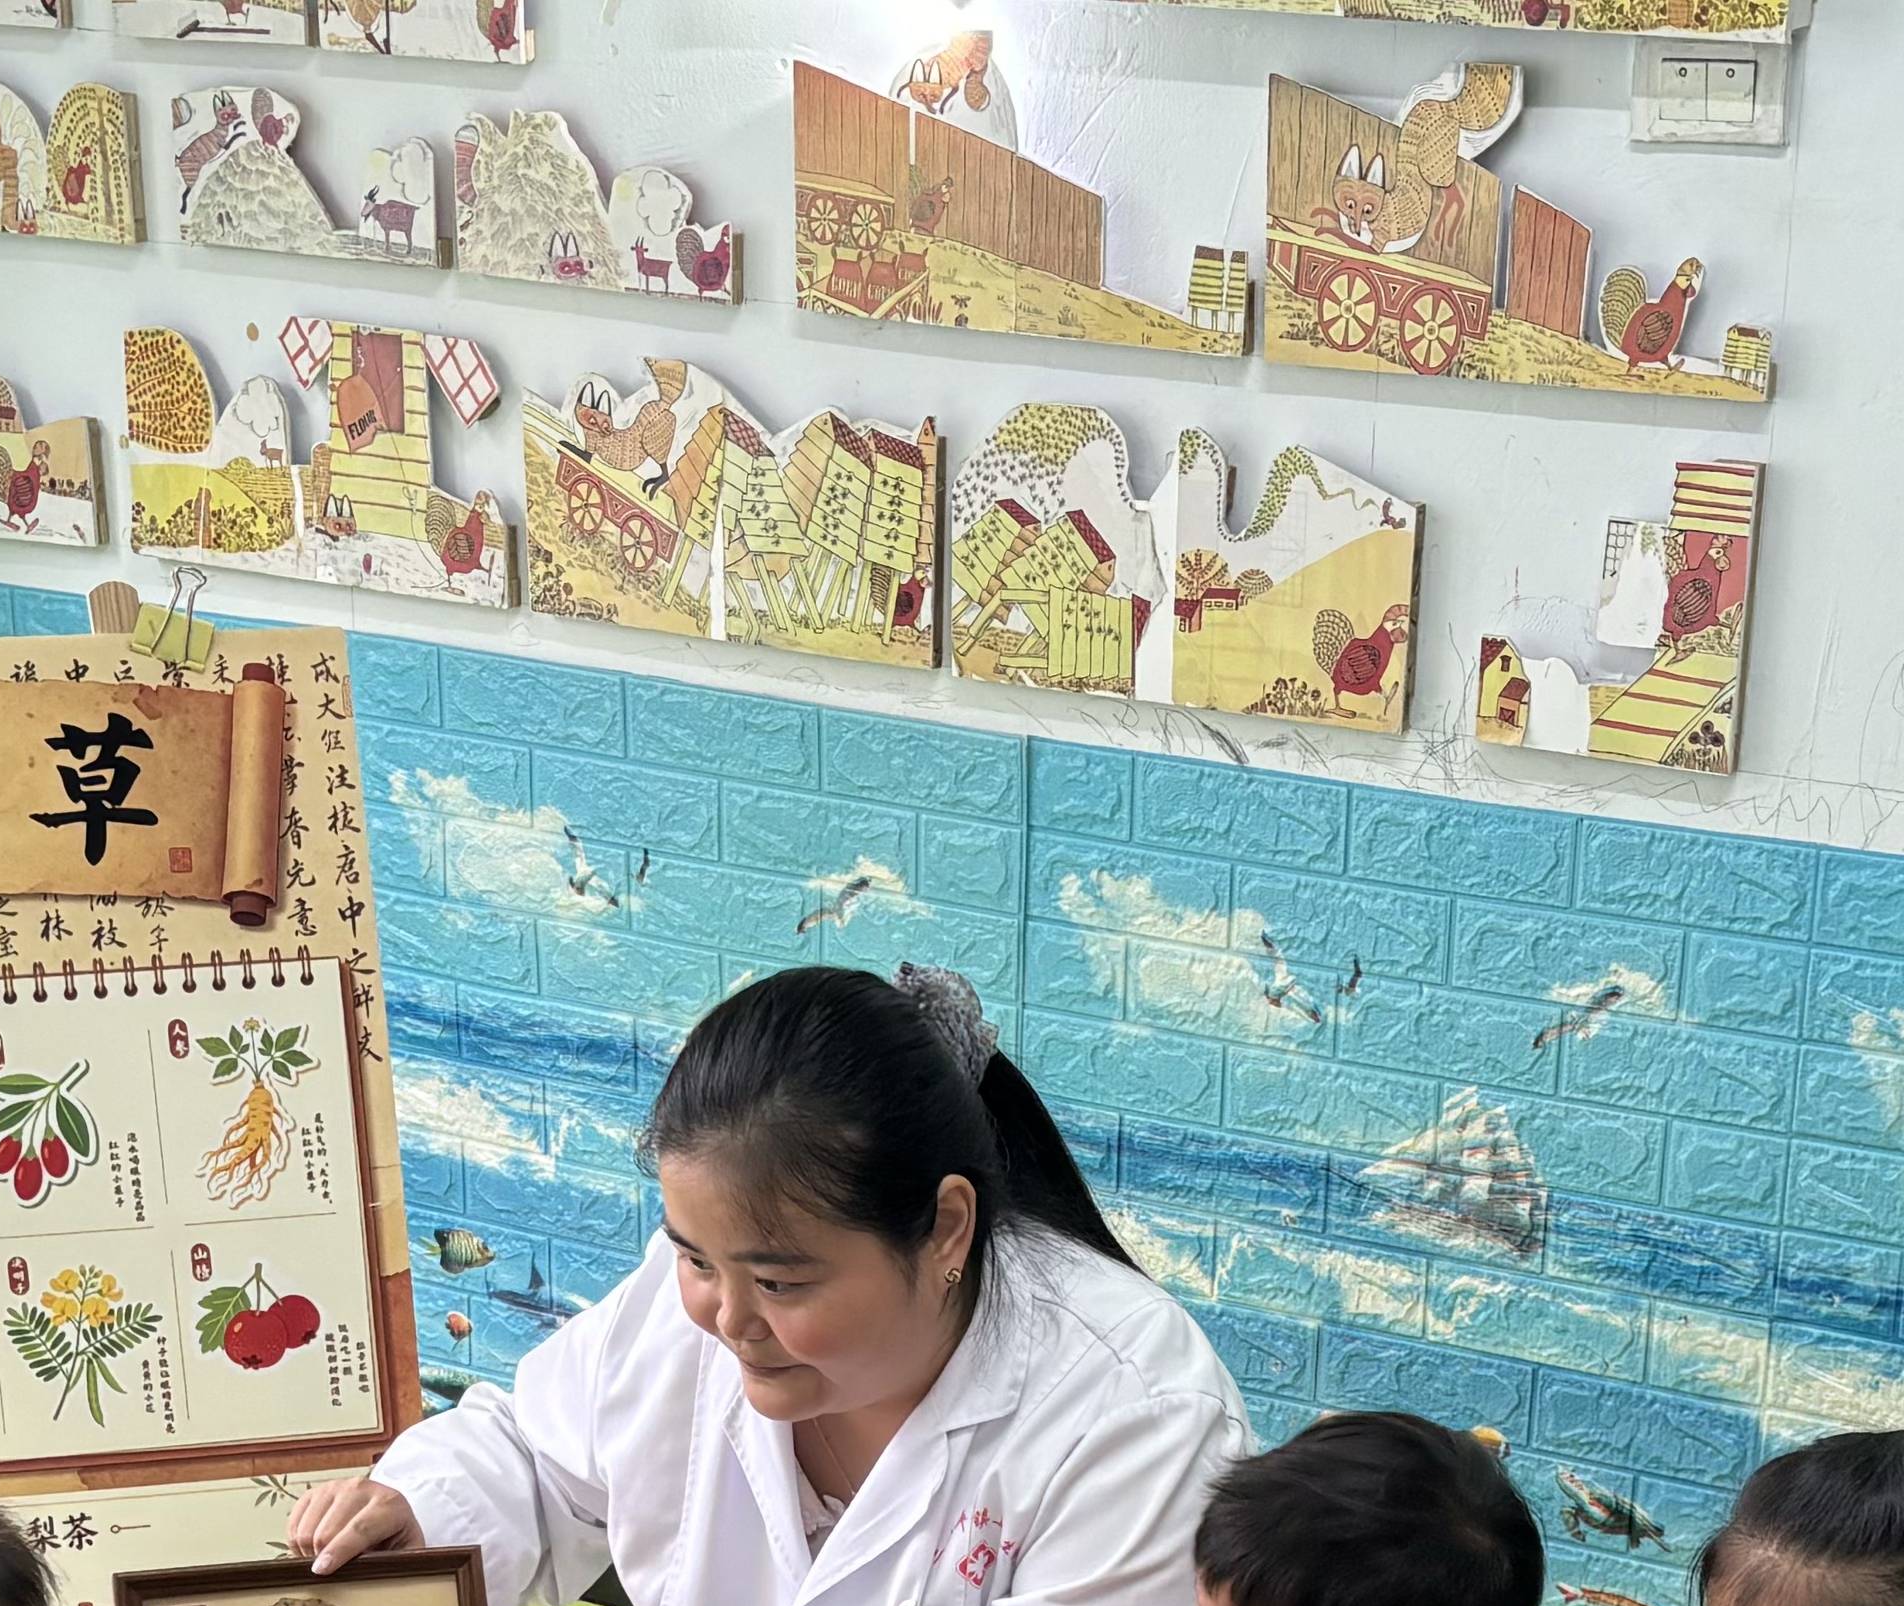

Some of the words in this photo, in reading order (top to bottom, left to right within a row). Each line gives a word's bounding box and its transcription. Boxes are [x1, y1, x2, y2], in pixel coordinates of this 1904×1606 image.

[347, 409, 377, 440] FLOUR
[171, 1023, 190, 1057] 人参
[194, 1246, 210, 1279] 山楂
